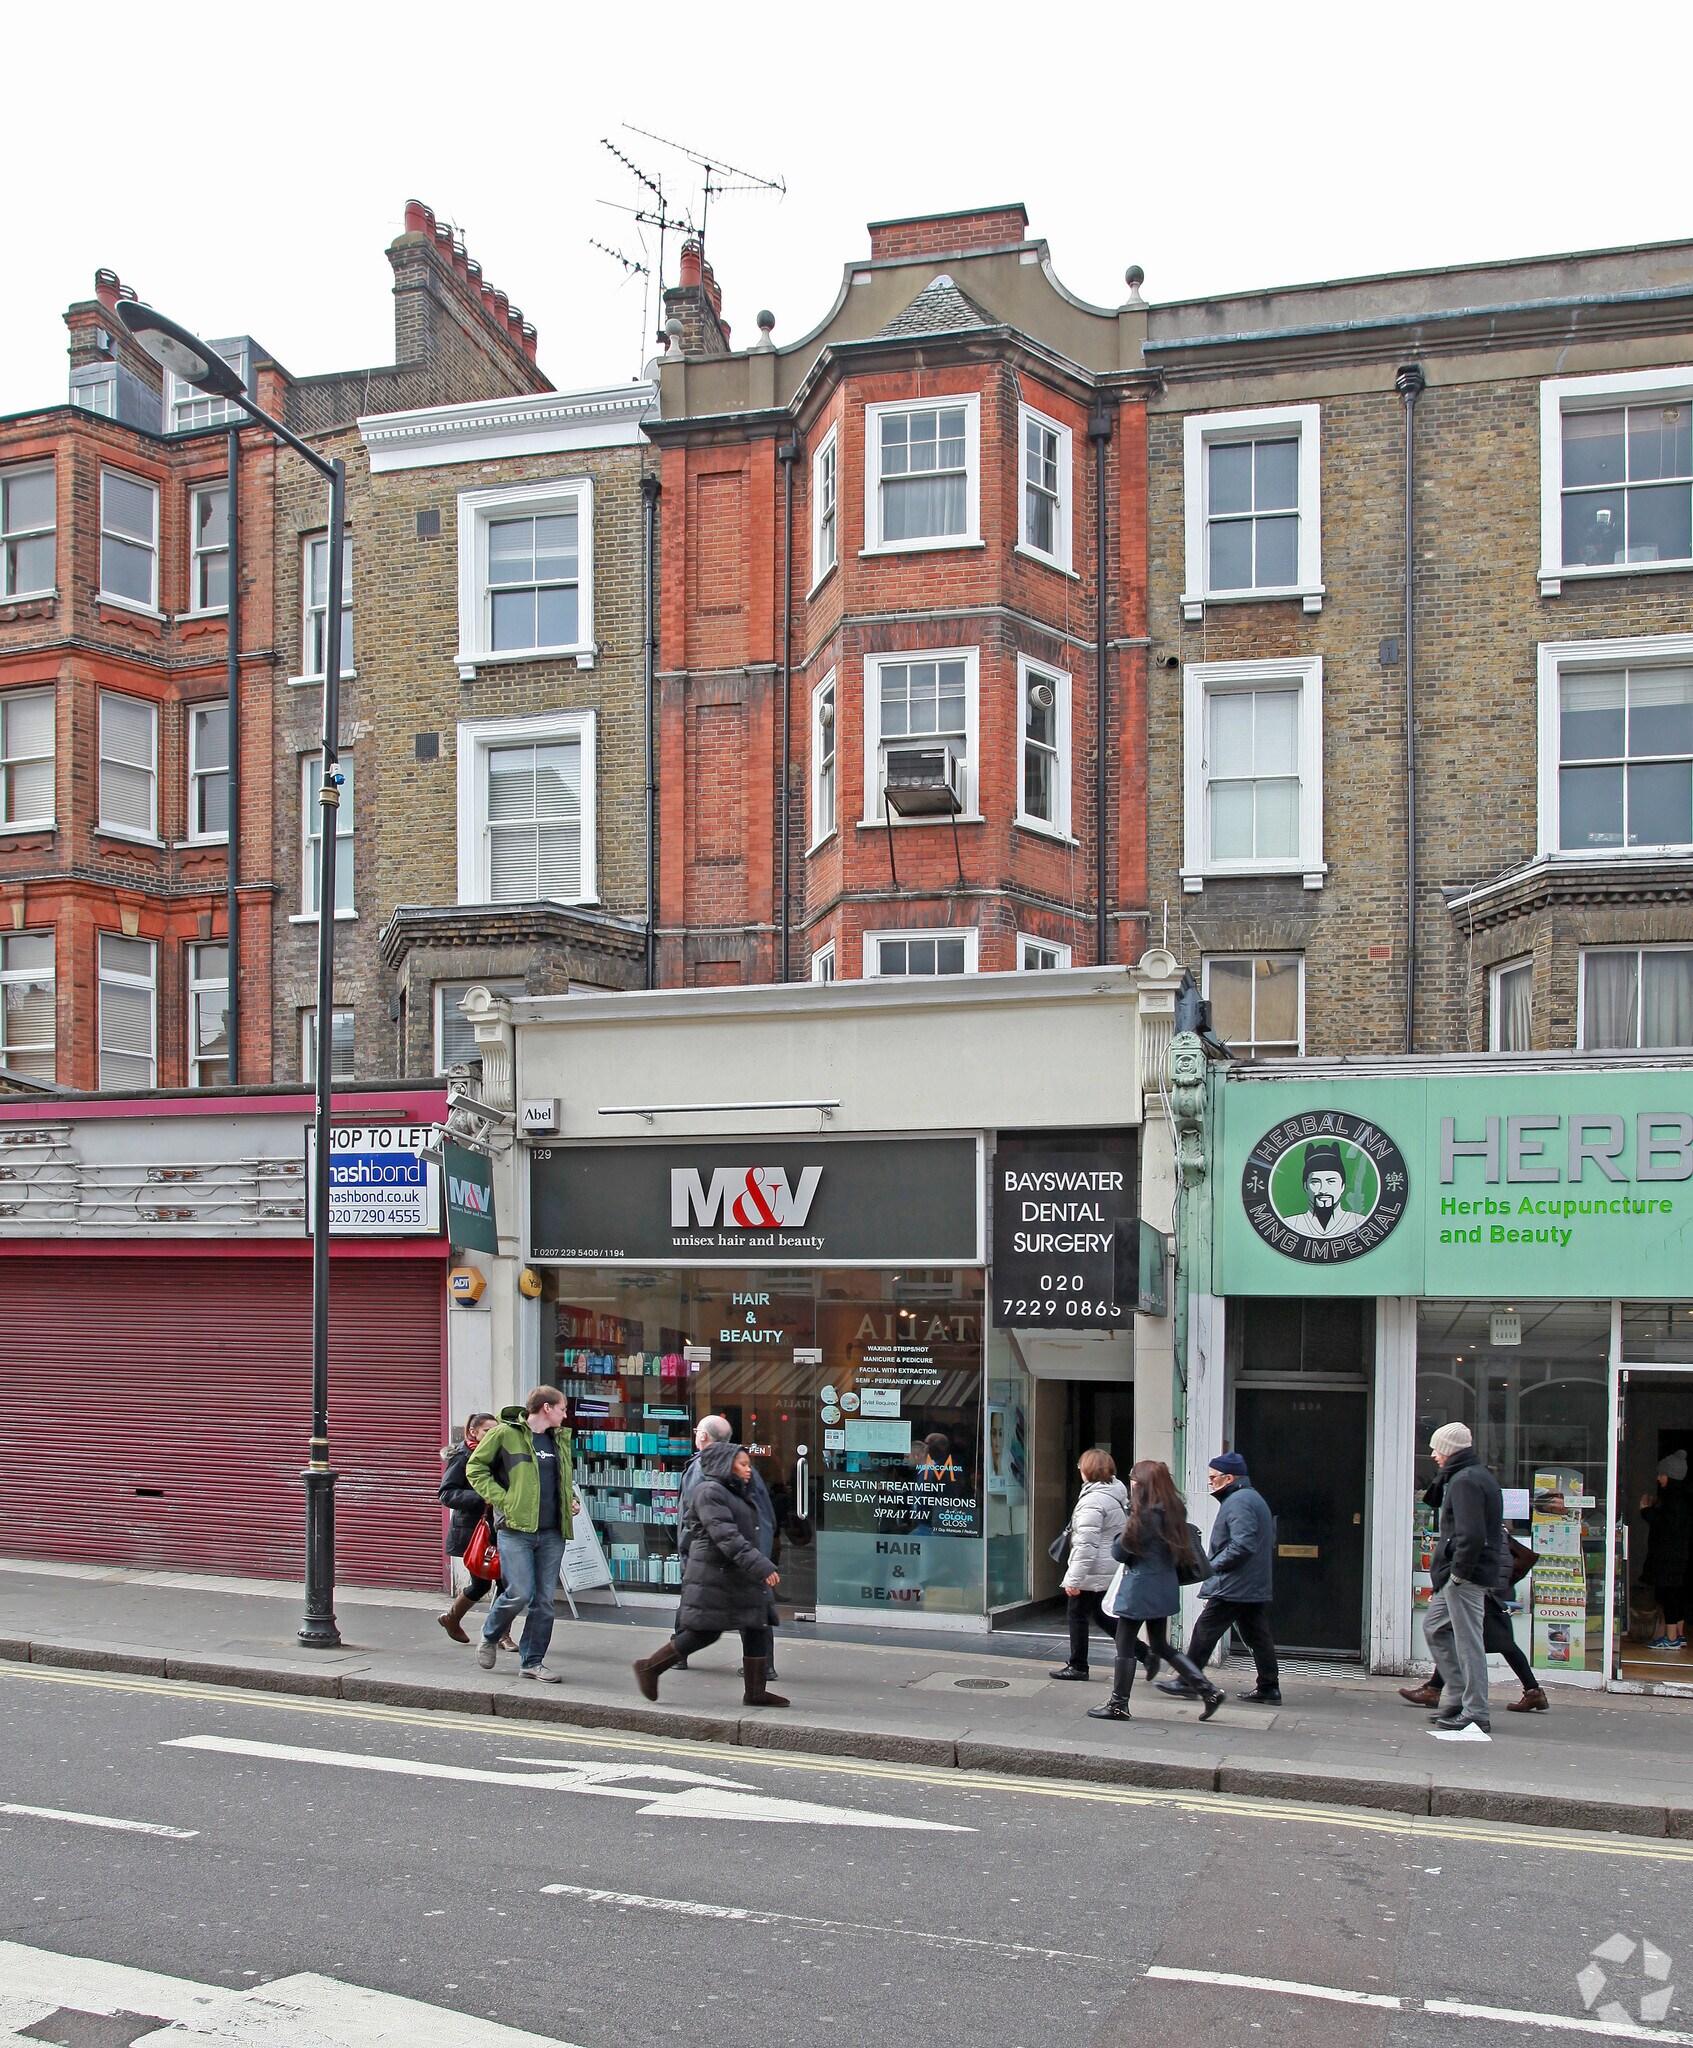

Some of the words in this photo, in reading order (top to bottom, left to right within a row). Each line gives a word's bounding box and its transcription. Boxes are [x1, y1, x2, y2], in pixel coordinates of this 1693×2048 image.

[525, 1108, 552, 1120] Abel
[312, 1129, 362, 1148] HOP
[368, 1130, 392, 1148] TO
[398, 1129, 433, 1148] LET
[1256, 1114, 1349, 1161] HERBAL
[1353, 1122, 1394, 1160] INN
[532, 1149, 552, 1160] 129
[1440, 1112, 1693, 1184] HERB
[1004, 1171, 1123, 1191] BAYSWATER
[1246, 1170, 1265, 1194] 永
[449, 1176, 490, 1213] M&V
[671, 1166, 824, 1228] M&V
[1021, 1202, 1105, 1222] DENTAL
[1440, 1197, 1511, 1216] Herbs
[1517, 1196, 1673, 1219] Acupuncture
[329, 1209, 351, 1223] 020
[353, 1209, 385, 1223] 7290
[388, 1209, 421, 1223] 4555
[1249, 1203, 1300, 1252] MING
[1303, 1202, 1402, 1259] IMPERIAL
[1439, 1225, 1481, 1243] and
[1490, 1224, 1573, 1247] Beauty
[672, 1234, 714, 1246] unisex
[718, 1233, 746, 1246] hair
[749, 1233, 774, 1246] and
[779, 1233, 825, 1250] beauty
[1013, 1232, 1113, 1253] SURGERY
[540, 1249, 559, 1257] 0207
[561, 1249, 576, 1257] 229
[453, 1277, 470, 1289] ADT
[529, 1278, 541, 1289] Yale
[1040, 1275, 1084, 1291] 020
[732, 1292, 770, 1306] HAIR
[1003, 1300, 1057, 1317] 7229
[745, 1311, 757, 1324] &
[720, 1329, 783, 1343] BEAUTY
[744, 1446, 766, 1454] PEN
[832, 1479, 877, 1490] KERATIN
[879, 1481, 946, 1492] TREATMENT
[823, 1492, 852, 1502] SAME
[855, 1493, 876, 1503] DAY
[879, 1494, 904, 1504] HAIR
[907, 1495, 977, 1508] EXTENSIONS
[873, 1508, 909, 1519] SPRAY
[909, 1510, 930, 1520] TAN
[938, 1513, 973, 1521] COLOUR
[942, 1520, 967, 1528] GLOSS
[876, 1541, 921, 1556] HAIR
[892, 1565, 905, 1578] &
[861, 1586, 921, 1602] BEAUT
[1539, 1609, 1578, 1617] OTOSAN
